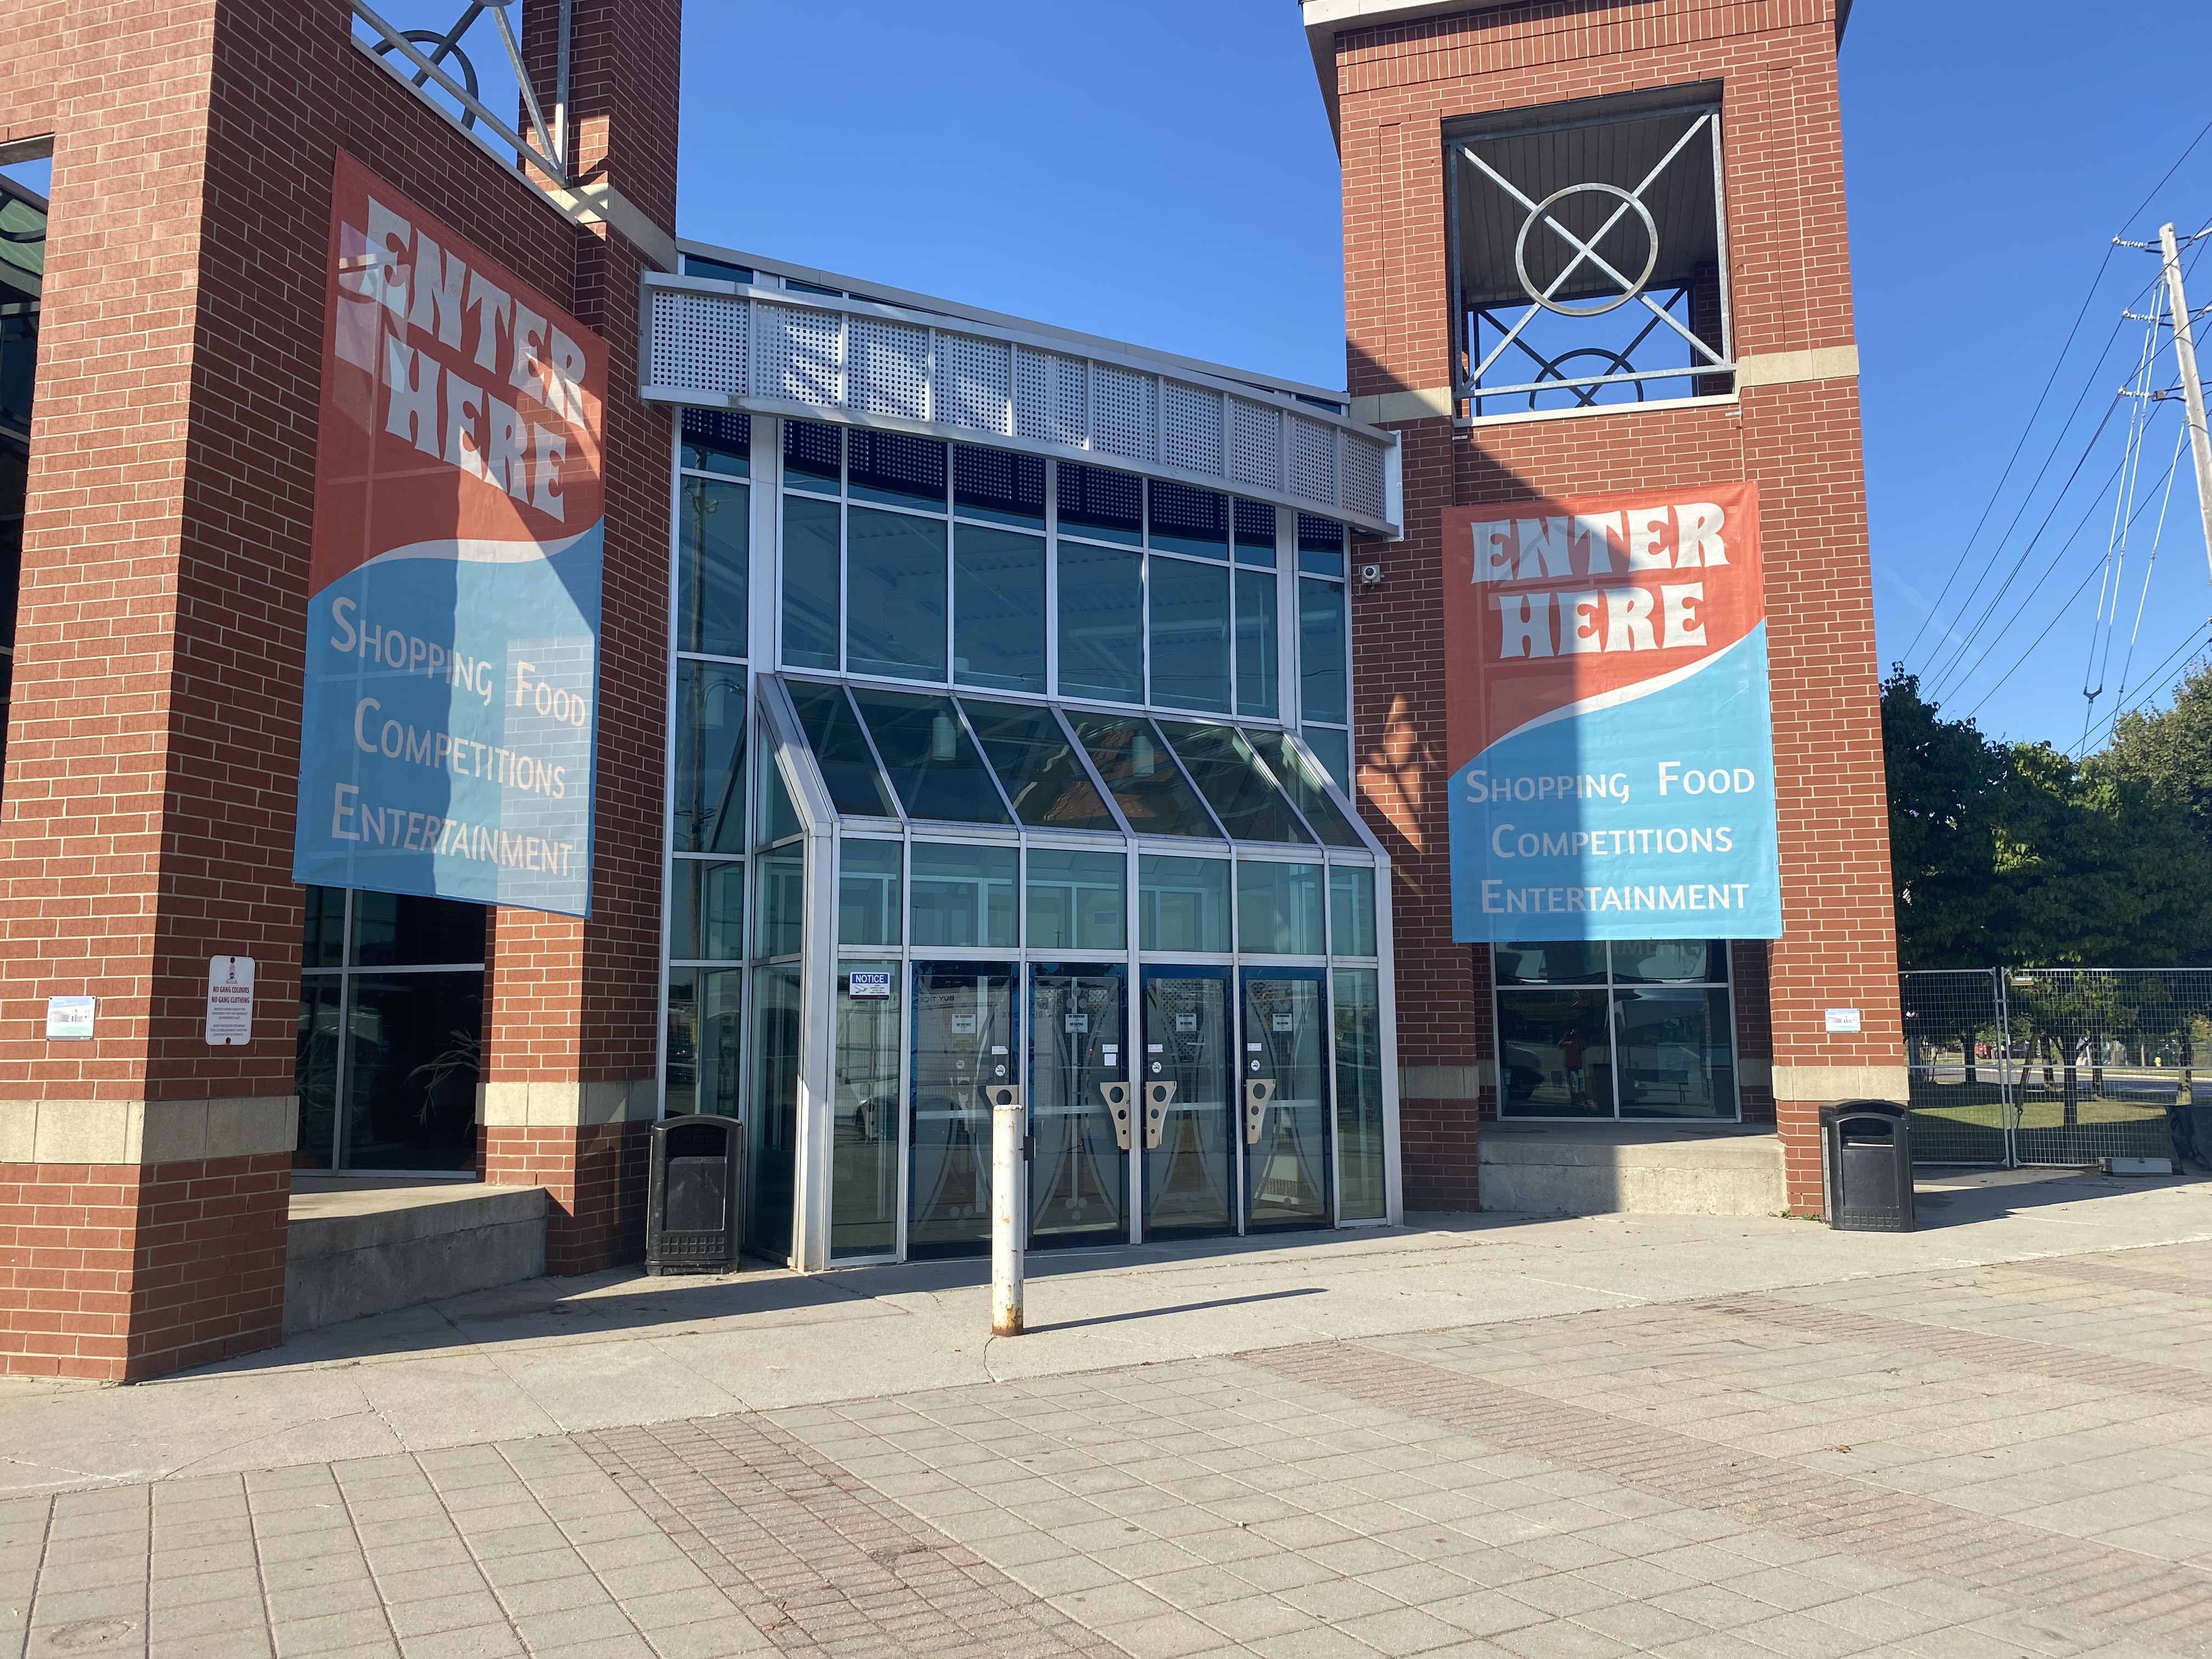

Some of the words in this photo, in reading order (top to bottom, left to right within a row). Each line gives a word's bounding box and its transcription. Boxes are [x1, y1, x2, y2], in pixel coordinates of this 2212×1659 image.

[365, 194, 586, 431] ENTER
[385, 332, 566, 523] HERE
[1470, 502, 1731, 584] ENTER
[330, 596, 492, 707] SHOPPING
[516, 659, 586, 727] FOOD
[1499, 582, 1707, 659] HERE
[354, 697, 566, 799] COMPETITIONS
[1466, 769, 1629, 804] SHOPPING
[1658, 761, 1755, 796] FOOD
[331, 782, 573, 877] ENTERTAINMENT
[1492, 824, 1733, 858] COMPETITIONS
[1481, 879, 1750, 913] ENTERTAINMENT
[855, 974, 884, 983] NOTICE
